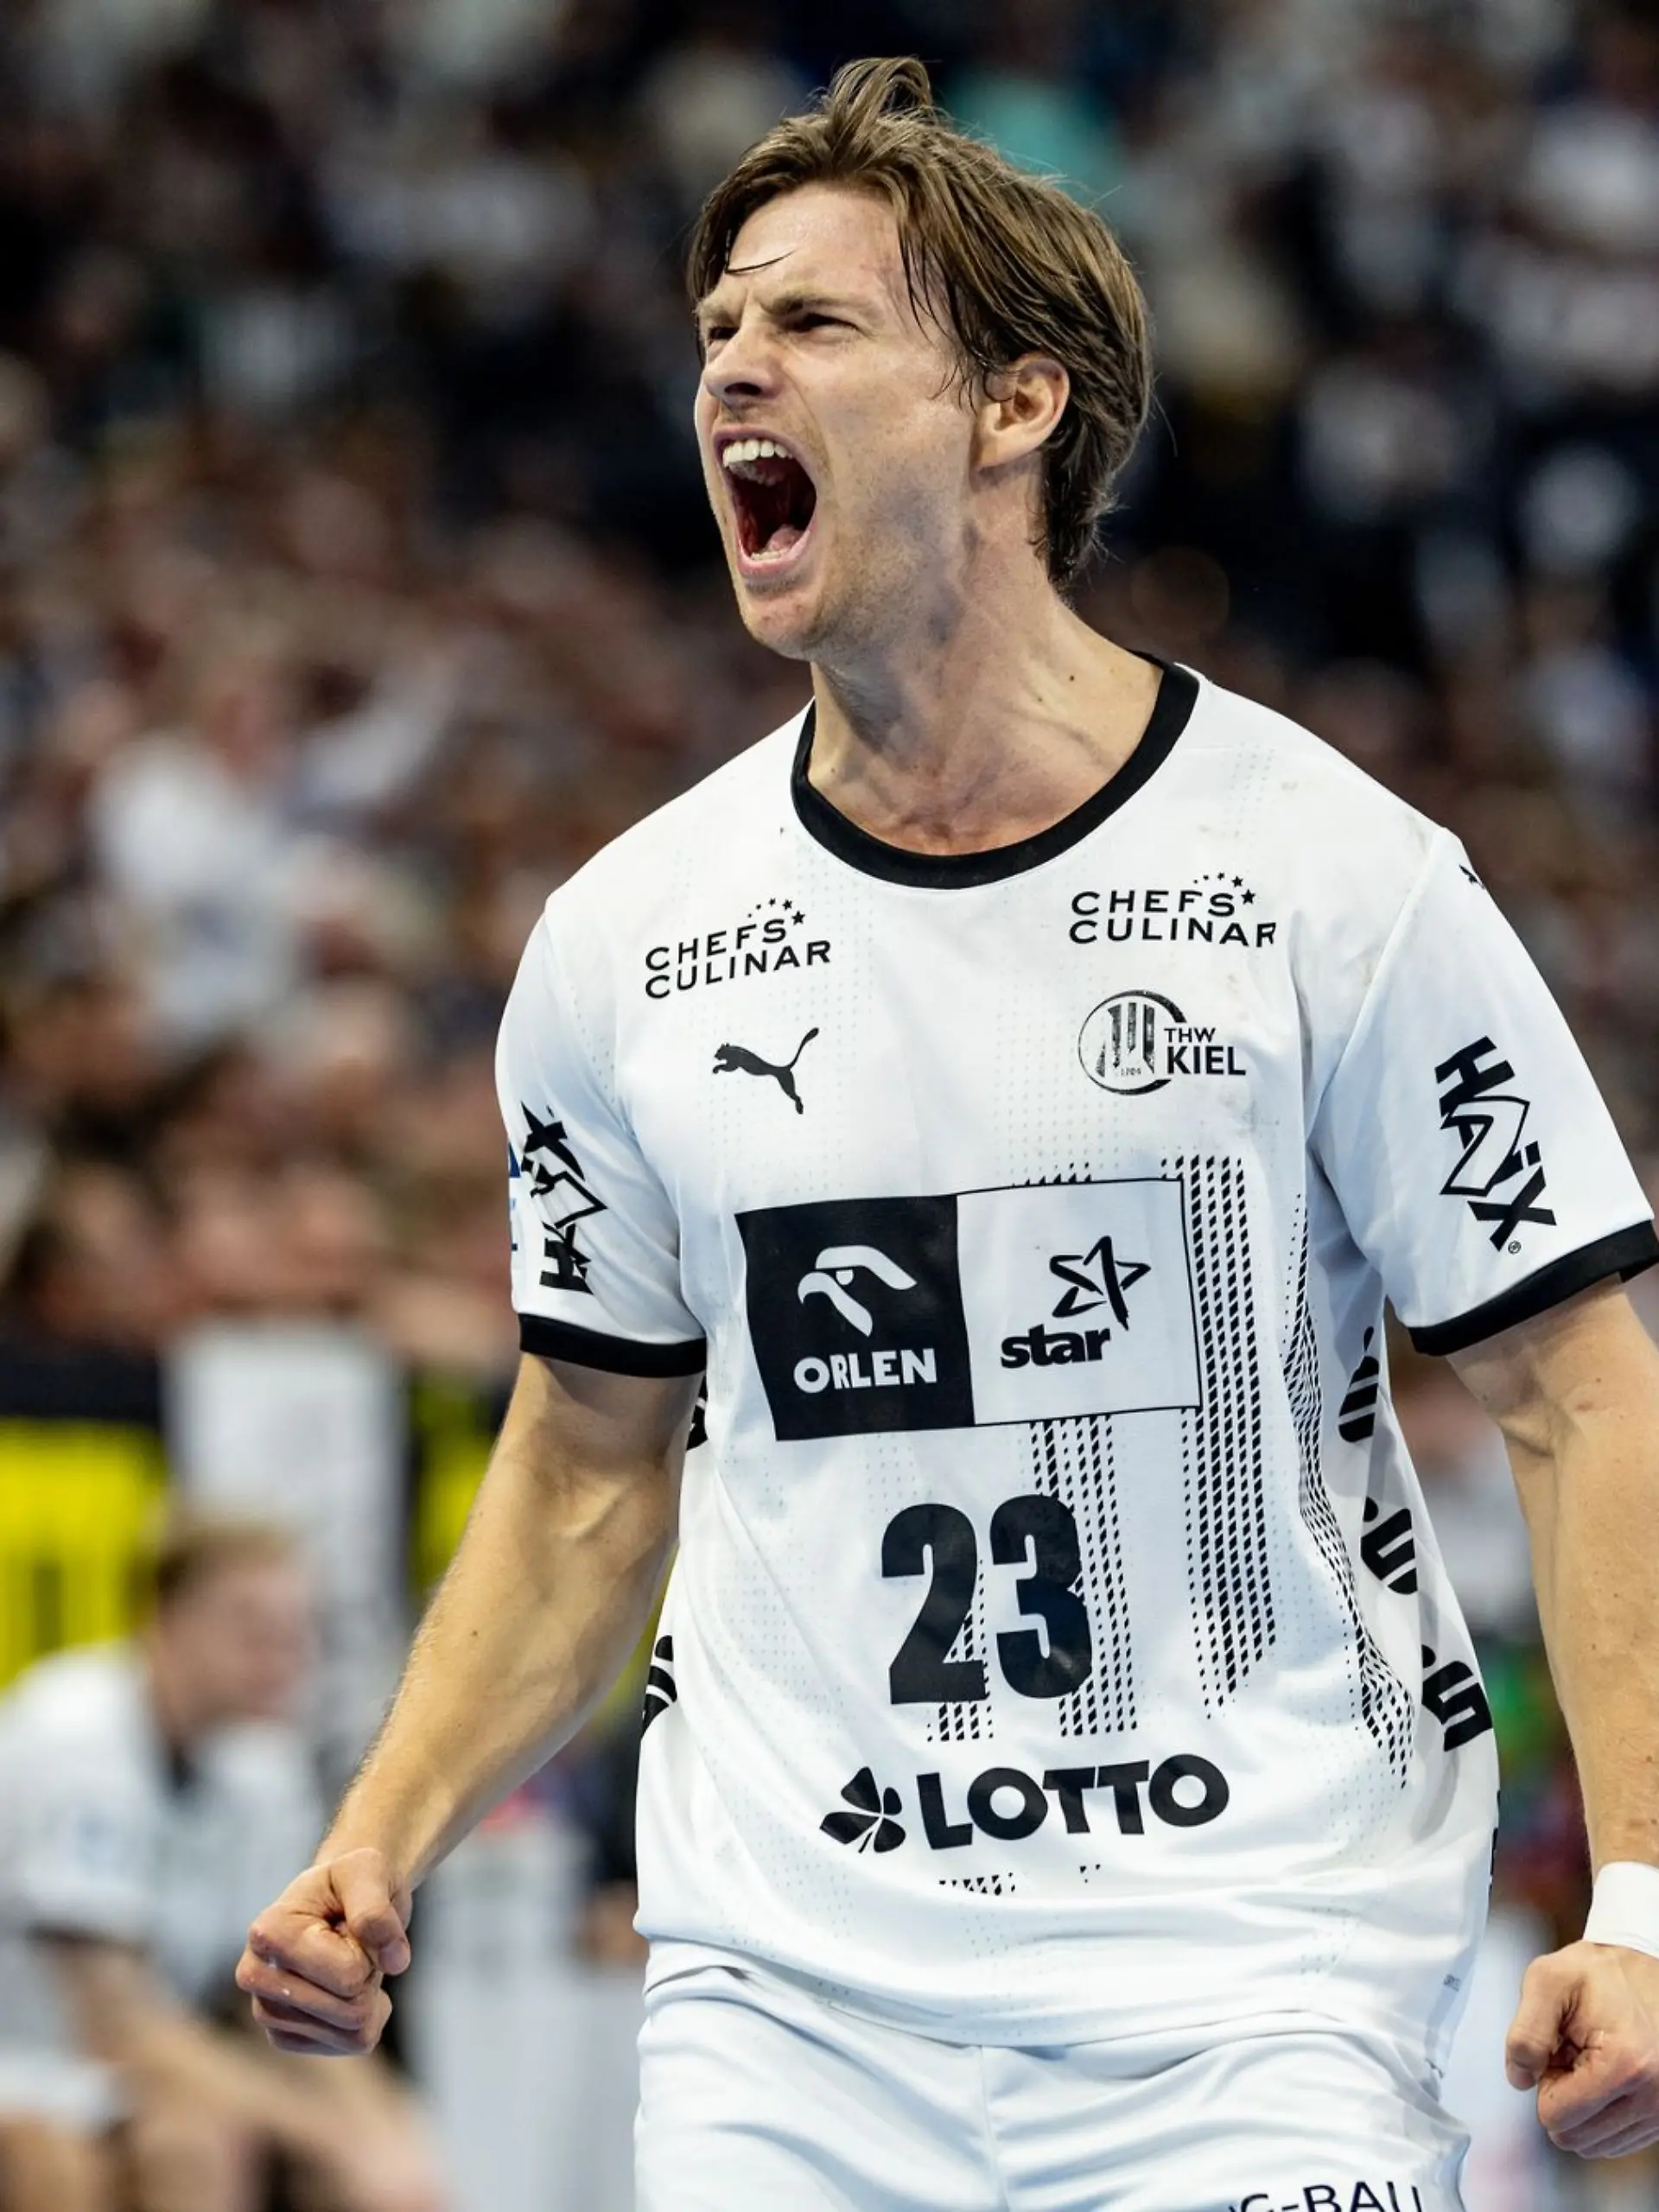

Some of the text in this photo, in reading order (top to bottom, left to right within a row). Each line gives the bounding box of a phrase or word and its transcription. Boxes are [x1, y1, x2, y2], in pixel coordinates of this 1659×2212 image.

[1071, 889, 1235, 918] CHEFS
[645, 918, 786, 971] CHEFS
[1069, 917, 1277, 948] CULINAR
[645, 940, 831, 999] CULINAR
[1163, 1027, 1216, 1043] THW
[1166, 1046, 1247, 1076] KIEL
[1000, 1323, 1112, 1370] star
[793, 1348, 938, 1394] ORLEN
[880, 1493, 1094, 1705] 23
[916, 1754, 1230, 1851] LOTTO
